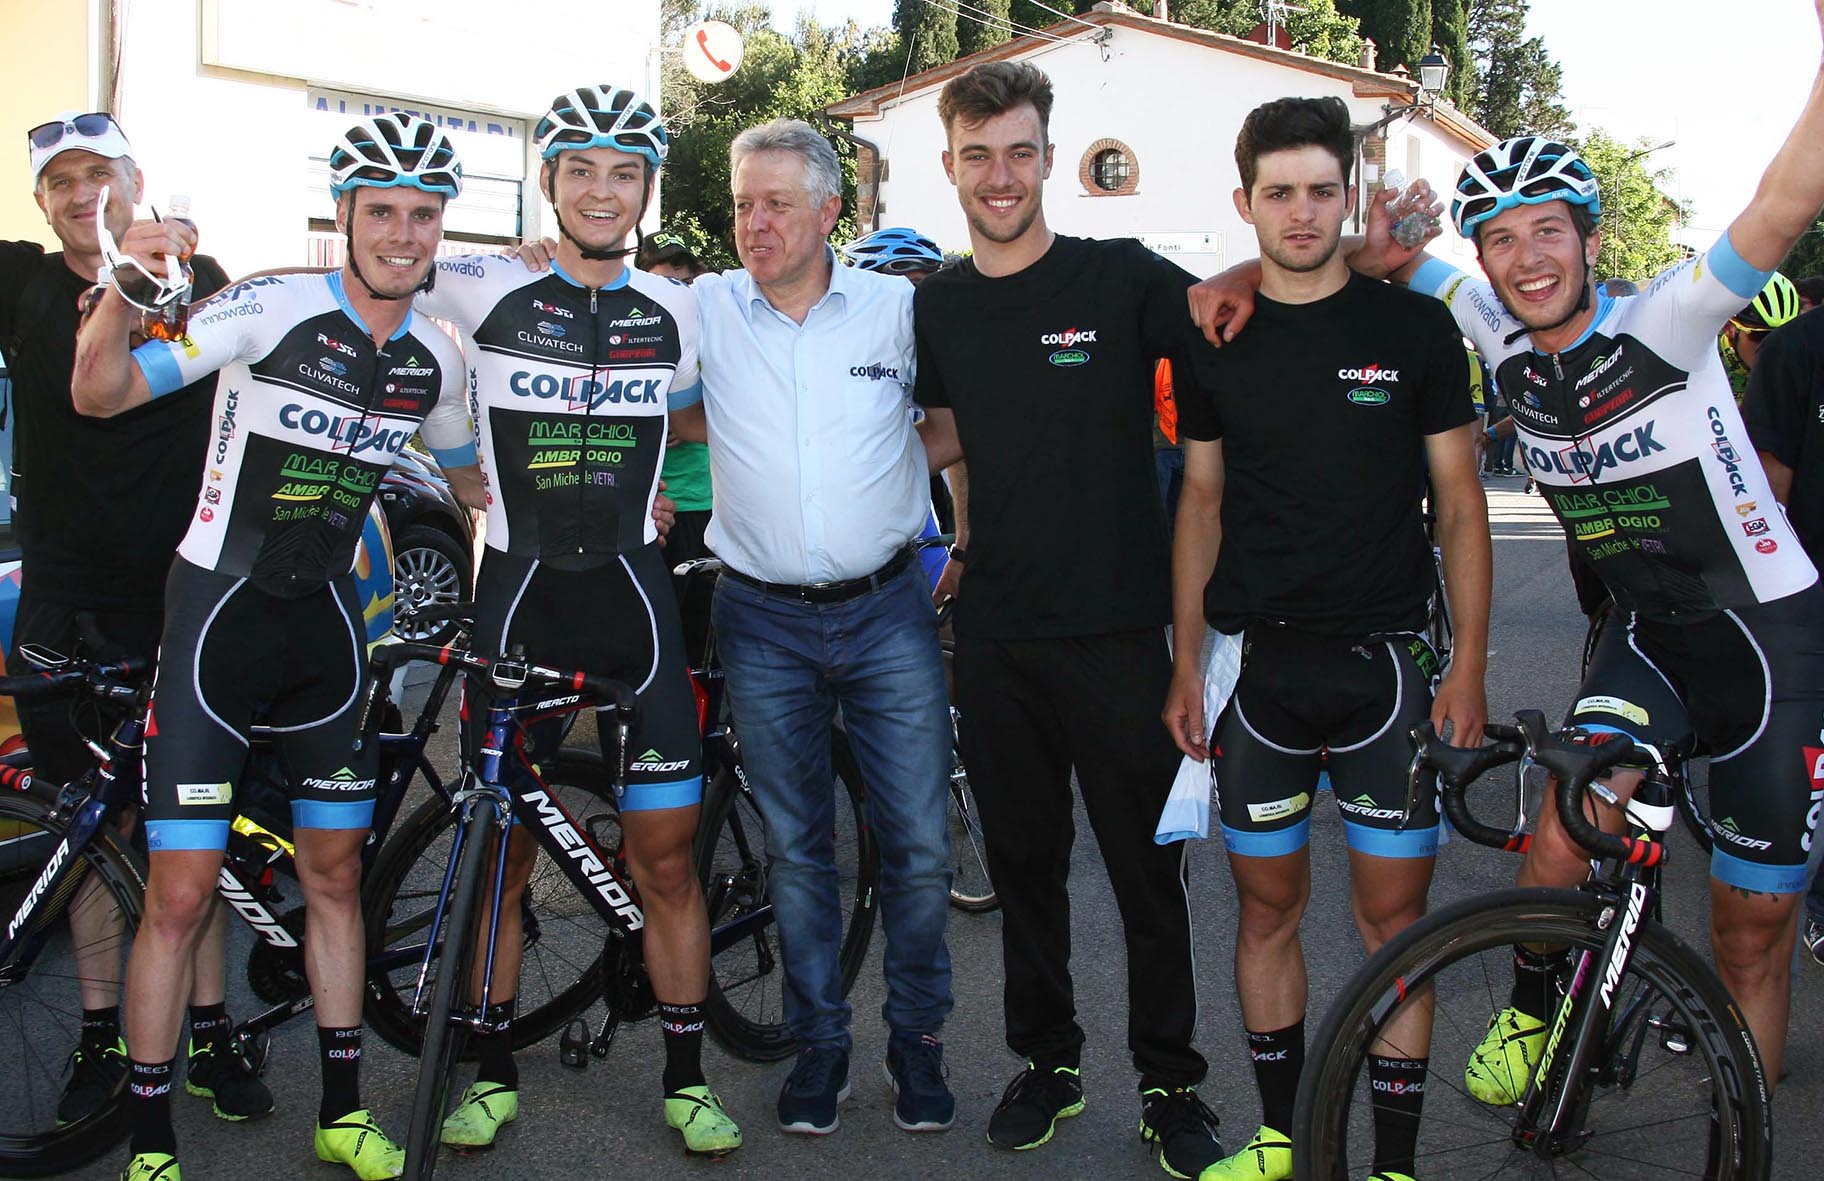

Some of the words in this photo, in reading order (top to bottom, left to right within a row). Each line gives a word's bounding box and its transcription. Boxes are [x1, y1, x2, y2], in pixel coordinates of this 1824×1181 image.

[1157, 243, 1182, 251] Fonti
[609, 315, 661, 328] MERIDA
[517, 330, 584, 353] CLIVATECH
[1040, 330, 1097, 347] COLPACK
[388, 367, 434, 376] MERIDA
[850, 365, 899, 381] COLPACK
[1338, 368, 1399, 384] COLPACK
[1574, 343, 1624, 391] MERIDA
[299, 363, 360, 396] CLIVATECH
[510, 370, 662, 410] COLPACK
[1511, 398, 1559, 425] CLIVATECH
[215, 389, 240, 465] COLPACK
[279, 403, 412, 453] COLPACK
[1519, 420, 1667, 479] COLPACK
[1707, 406, 1748, 497] COLPACK
[535, 474, 552, 490] San
[272, 506, 291, 521] San
[536, 695, 580, 710] REACTO
[480, 747, 503, 757] RIDA
[629, 759, 690, 772] ERIDA
[302, 777, 376, 791] MERIDA
[1336, 798, 1404, 820] MERIDA
[1711, 818, 1773, 851] MERIDA
[521, 789, 645, 932] MERIDA
[8, 837, 70, 940] MERIDA
[216, 866, 298, 947] RIDA
[1600, 882, 1647, 1010] MERID
[1535, 993, 1573, 1091] REACTO
[328, 1049, 361, 1060] COLPA
[1251, 1049, 1288, 1061] PACK
[1740, 1031, 1767, 1103] COMPETITION
